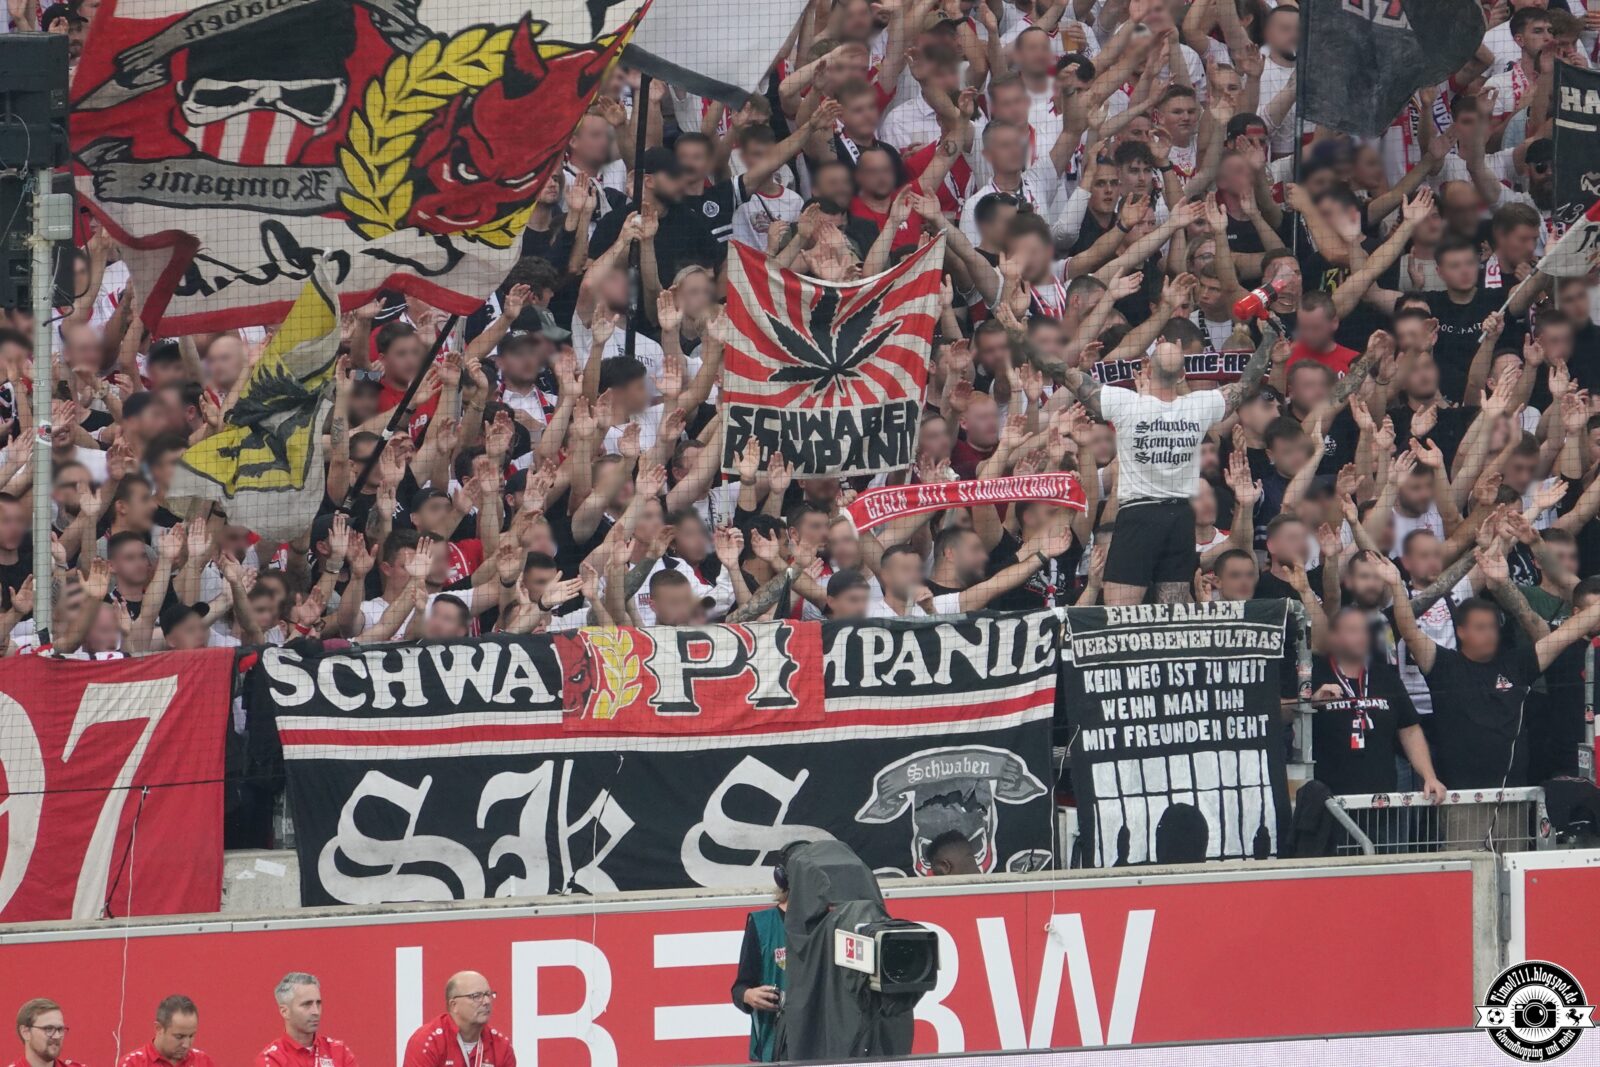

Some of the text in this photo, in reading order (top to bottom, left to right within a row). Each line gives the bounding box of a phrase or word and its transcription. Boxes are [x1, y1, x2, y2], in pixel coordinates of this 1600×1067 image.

[864, 490, 907, 520] GEGEN
[1104, 600, 1245, 625] EHRE ALLEN
[1073, 628, 1281, 658] VERSTORBENEN ULTRAS
[1083, 659, 1268, 693] KEIN WEG IST ZU WEIT
[1101, 694, 1156, 721] WENN
[1163, 689, 1209, 716] MAN
[1082, 714, 1269, 752] MIT FREUNDEN GEHT
[907, 757, 990, 784] Schwaben
